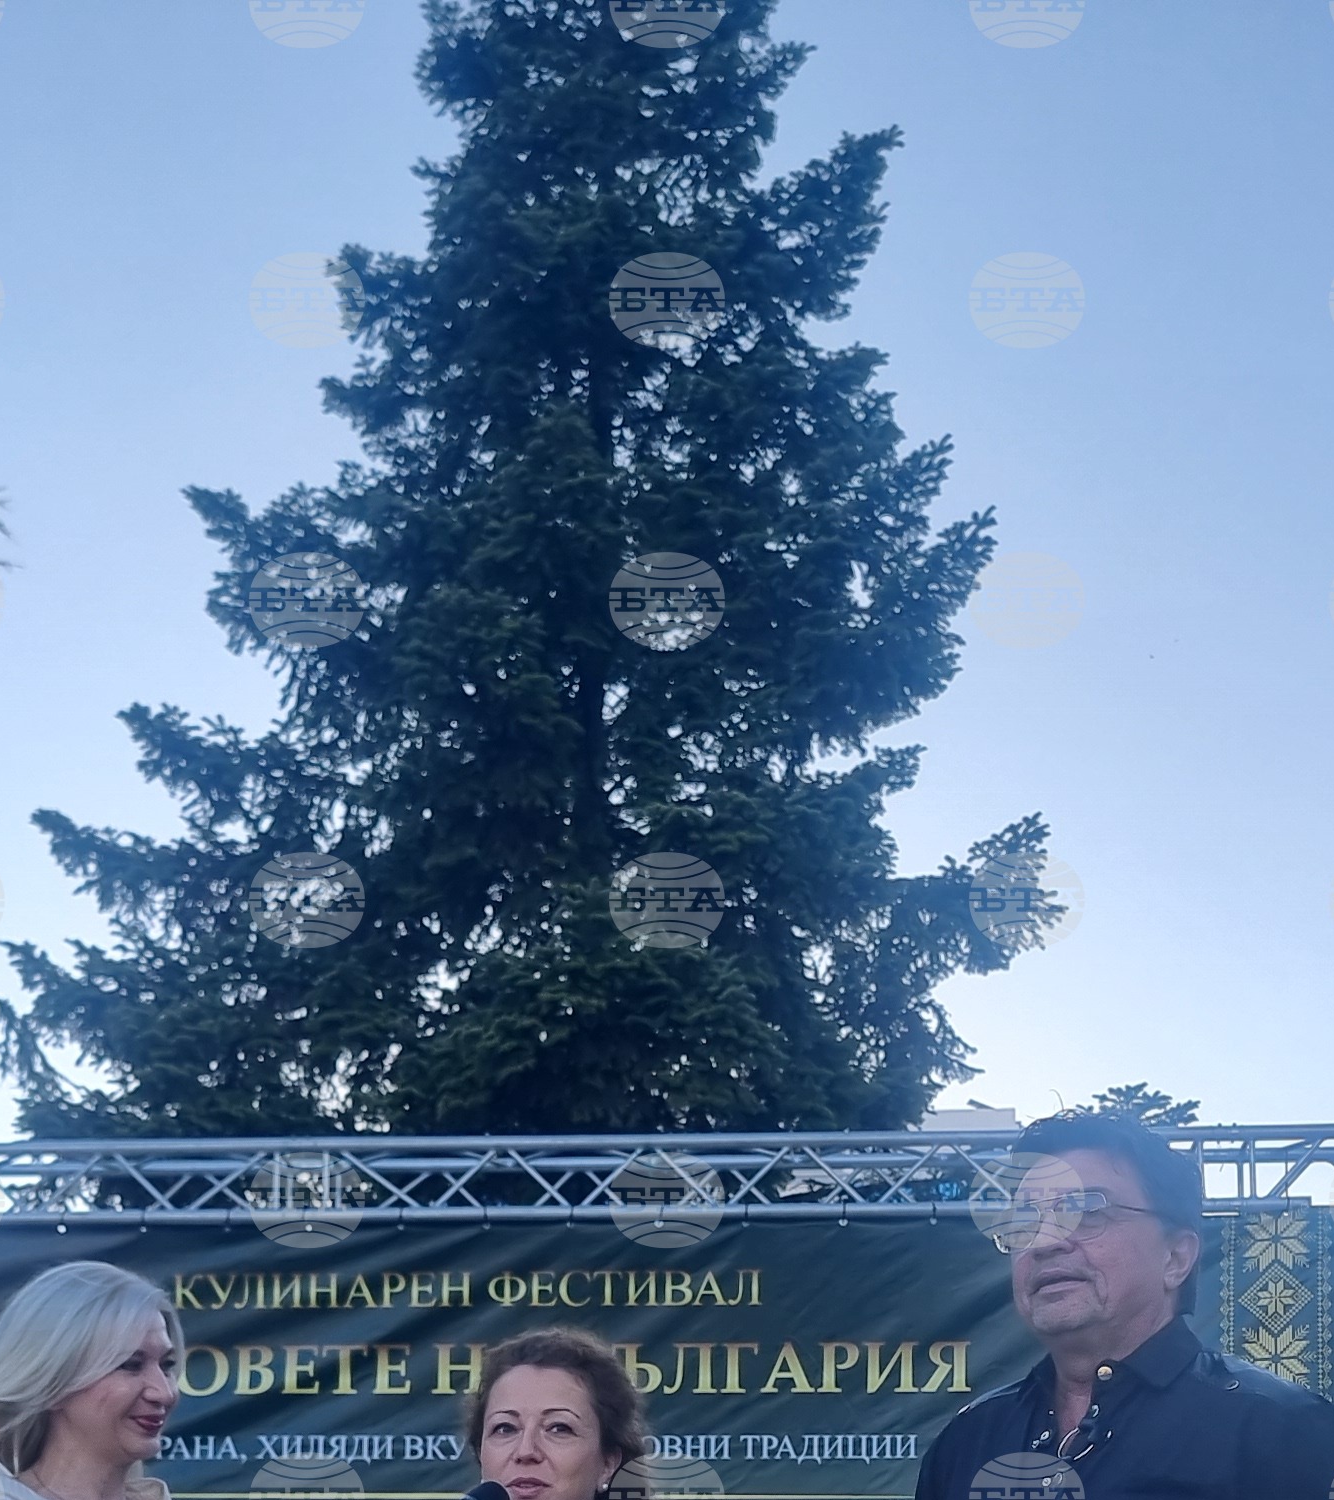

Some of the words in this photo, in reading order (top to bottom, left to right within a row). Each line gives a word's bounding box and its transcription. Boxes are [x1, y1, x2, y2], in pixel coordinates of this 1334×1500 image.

[174, 1272, 472, 1309] КУЛИНАРЕН
[488, 1269, 763, 1308] ФЕСТИВАЛ
[255, 1434, 394, 1465] ХИЛЯДИ
[739, 1433, 918, 1465] ТРАДИЦИИ
